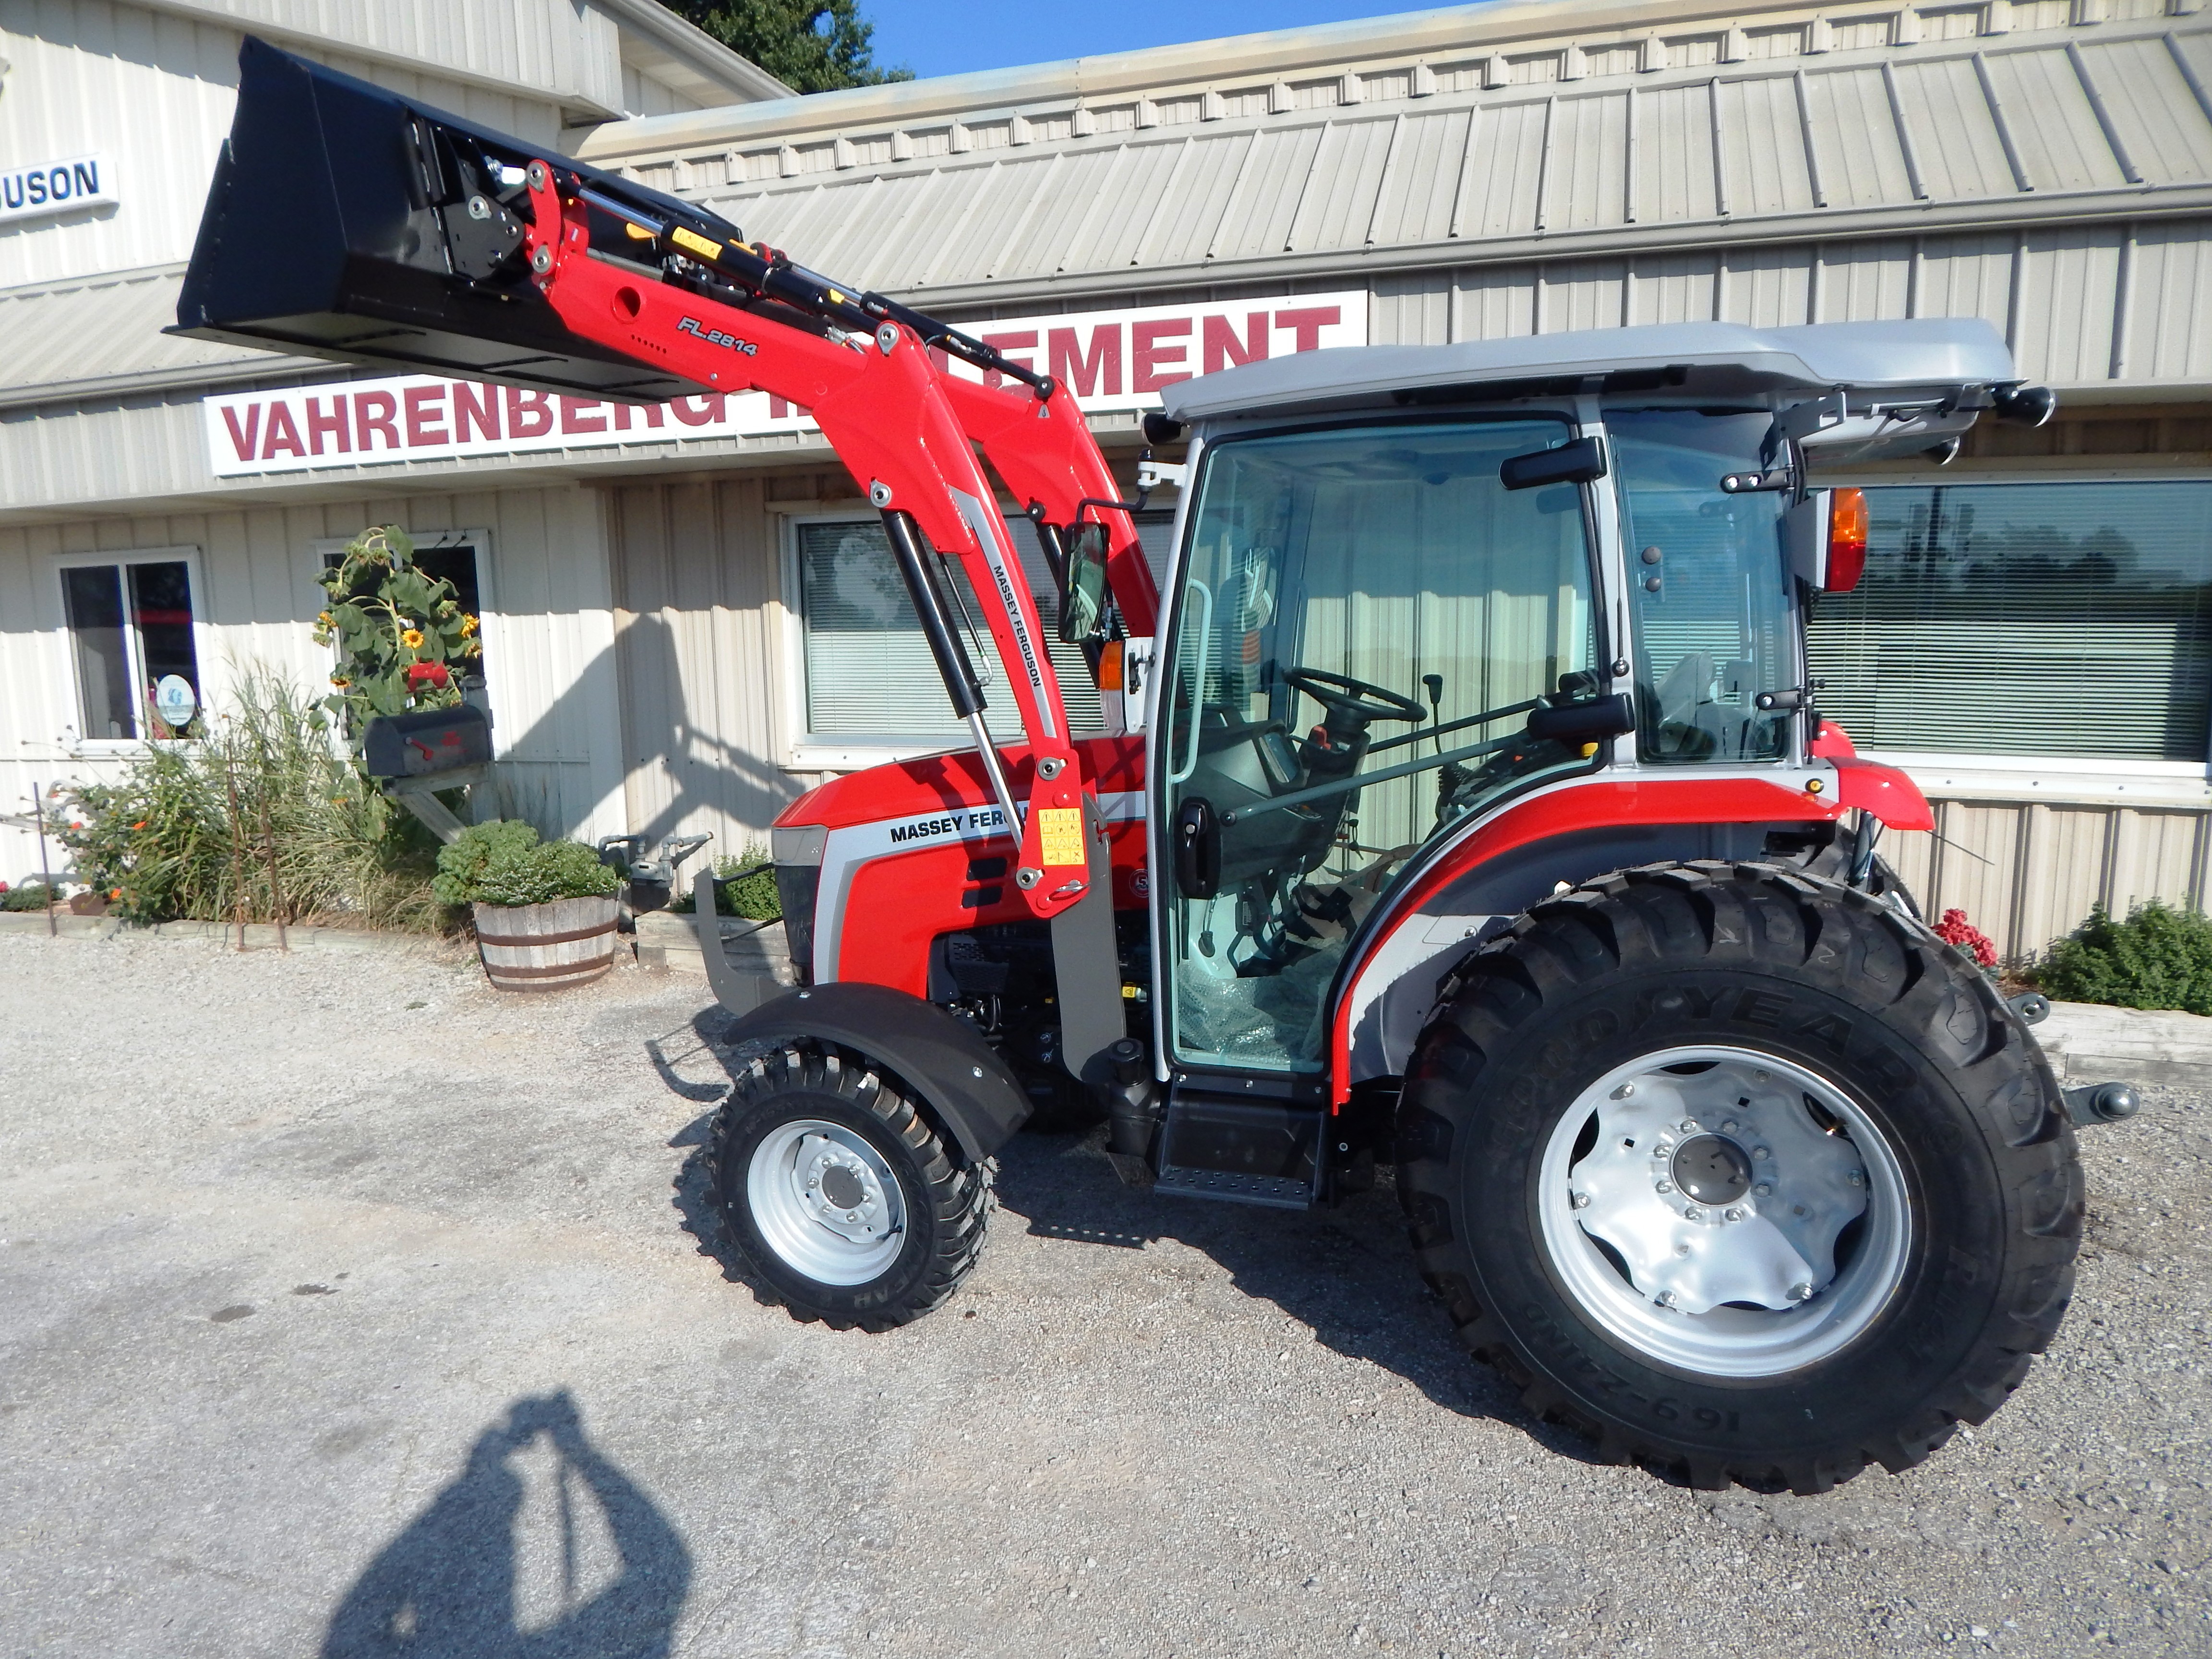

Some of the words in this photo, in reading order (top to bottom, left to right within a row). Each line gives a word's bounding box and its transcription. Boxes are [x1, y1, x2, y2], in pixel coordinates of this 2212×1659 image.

[0, 160, 100, 210] USON
[676, 315, 758, 356] FL.2814
[994, 565, 1019, 616] MASSEY
[1014, 620, 1041, 687] FERGUSON
[890, 816, 962, 842] MASSEY
